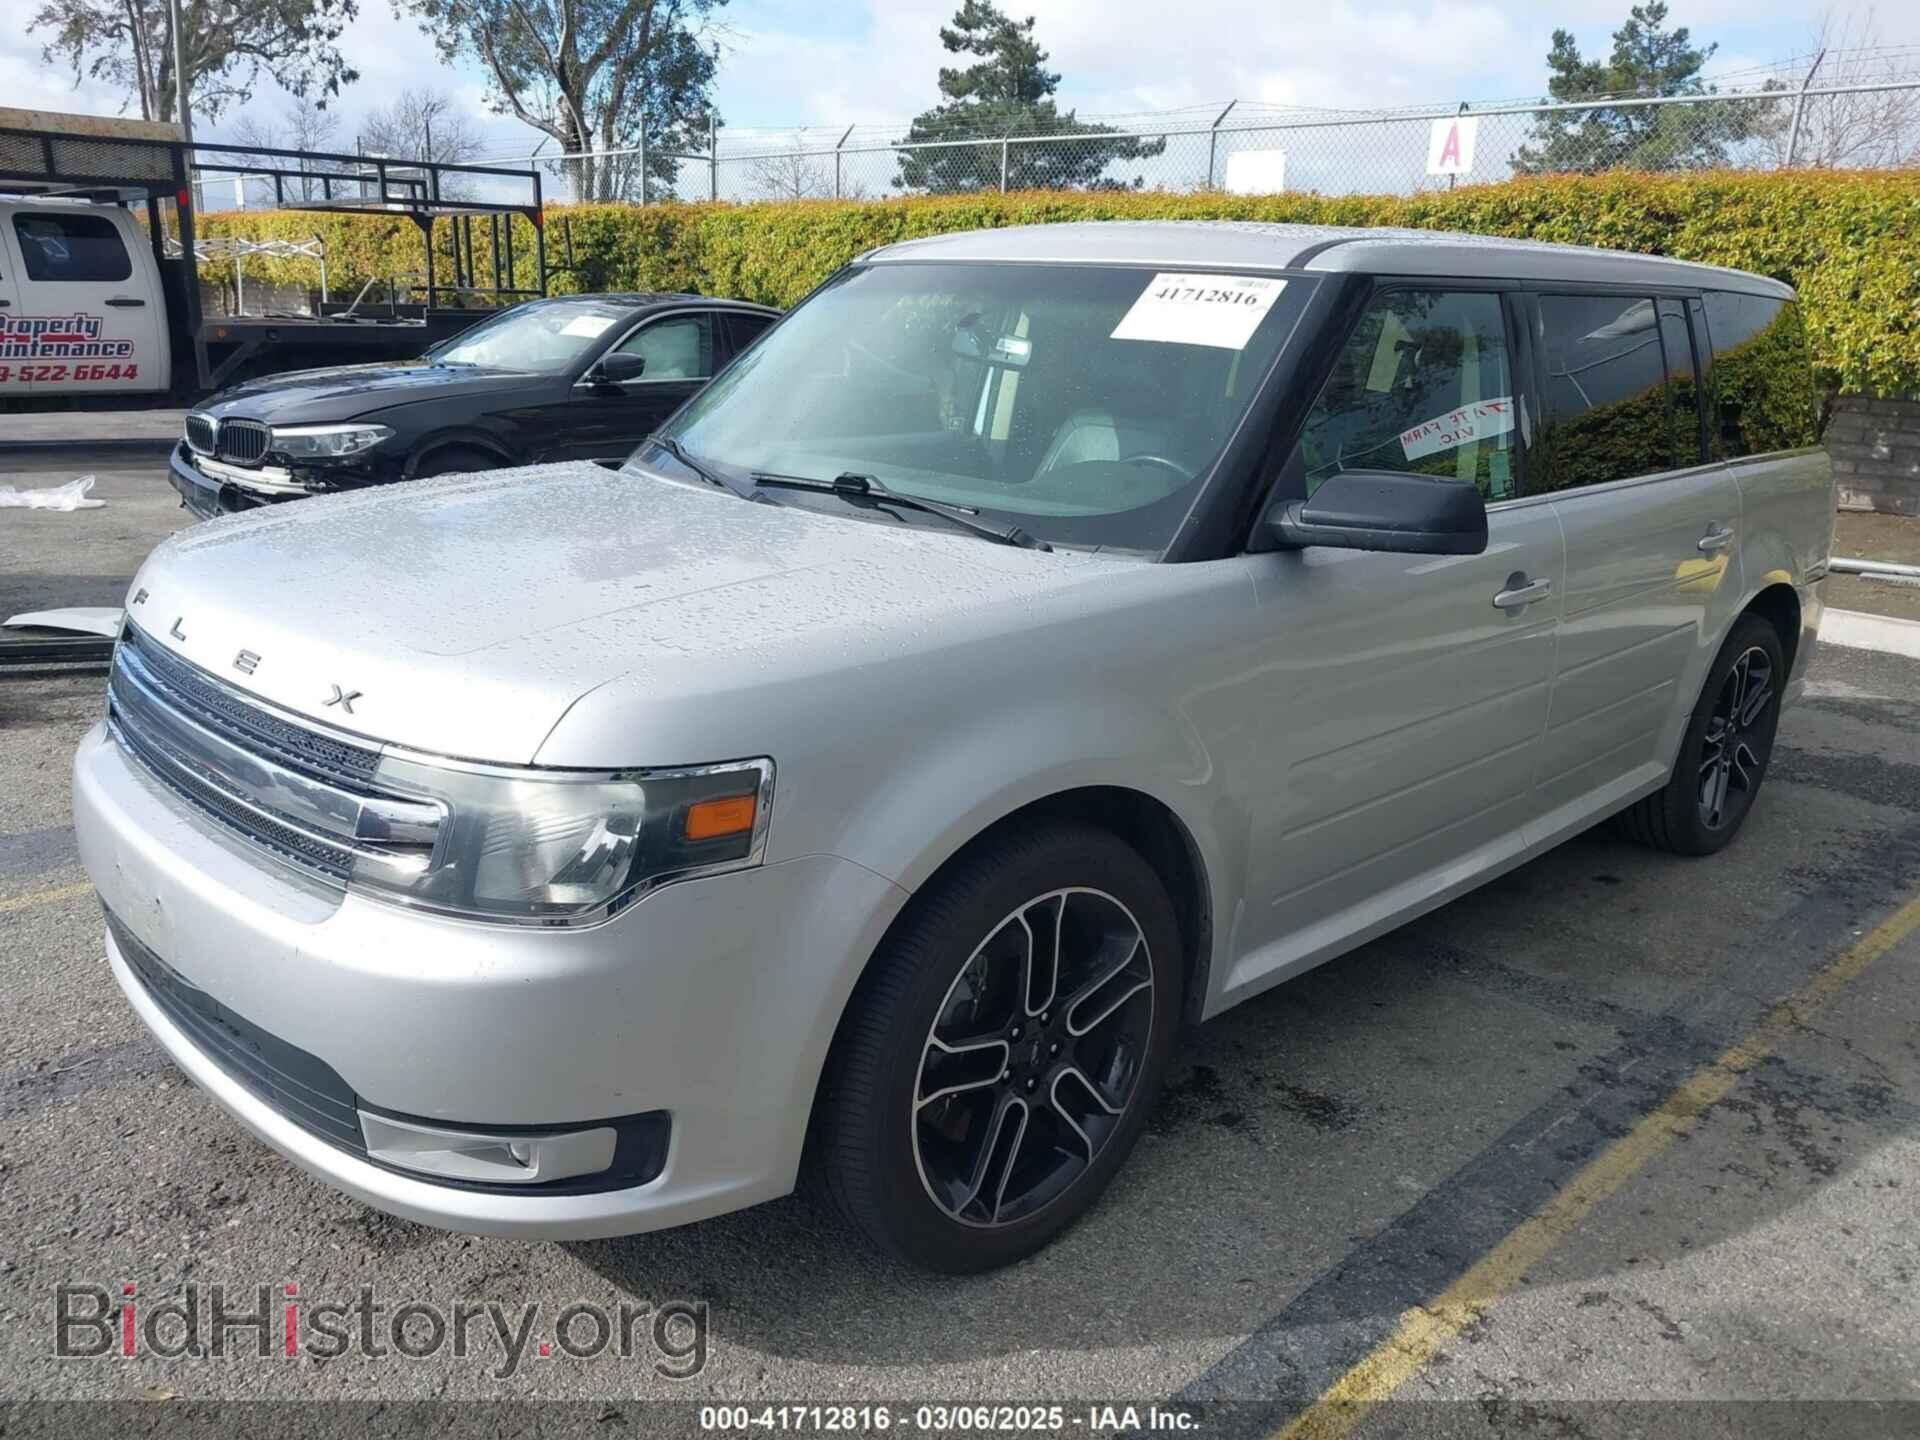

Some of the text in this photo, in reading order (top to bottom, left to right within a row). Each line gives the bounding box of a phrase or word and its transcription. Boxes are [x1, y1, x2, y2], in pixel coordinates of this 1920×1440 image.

[1439, 121, 1461, 167] A
[1155, 287, 1258, 306] 41712816
[132, 587, 364, 714] FLEX
